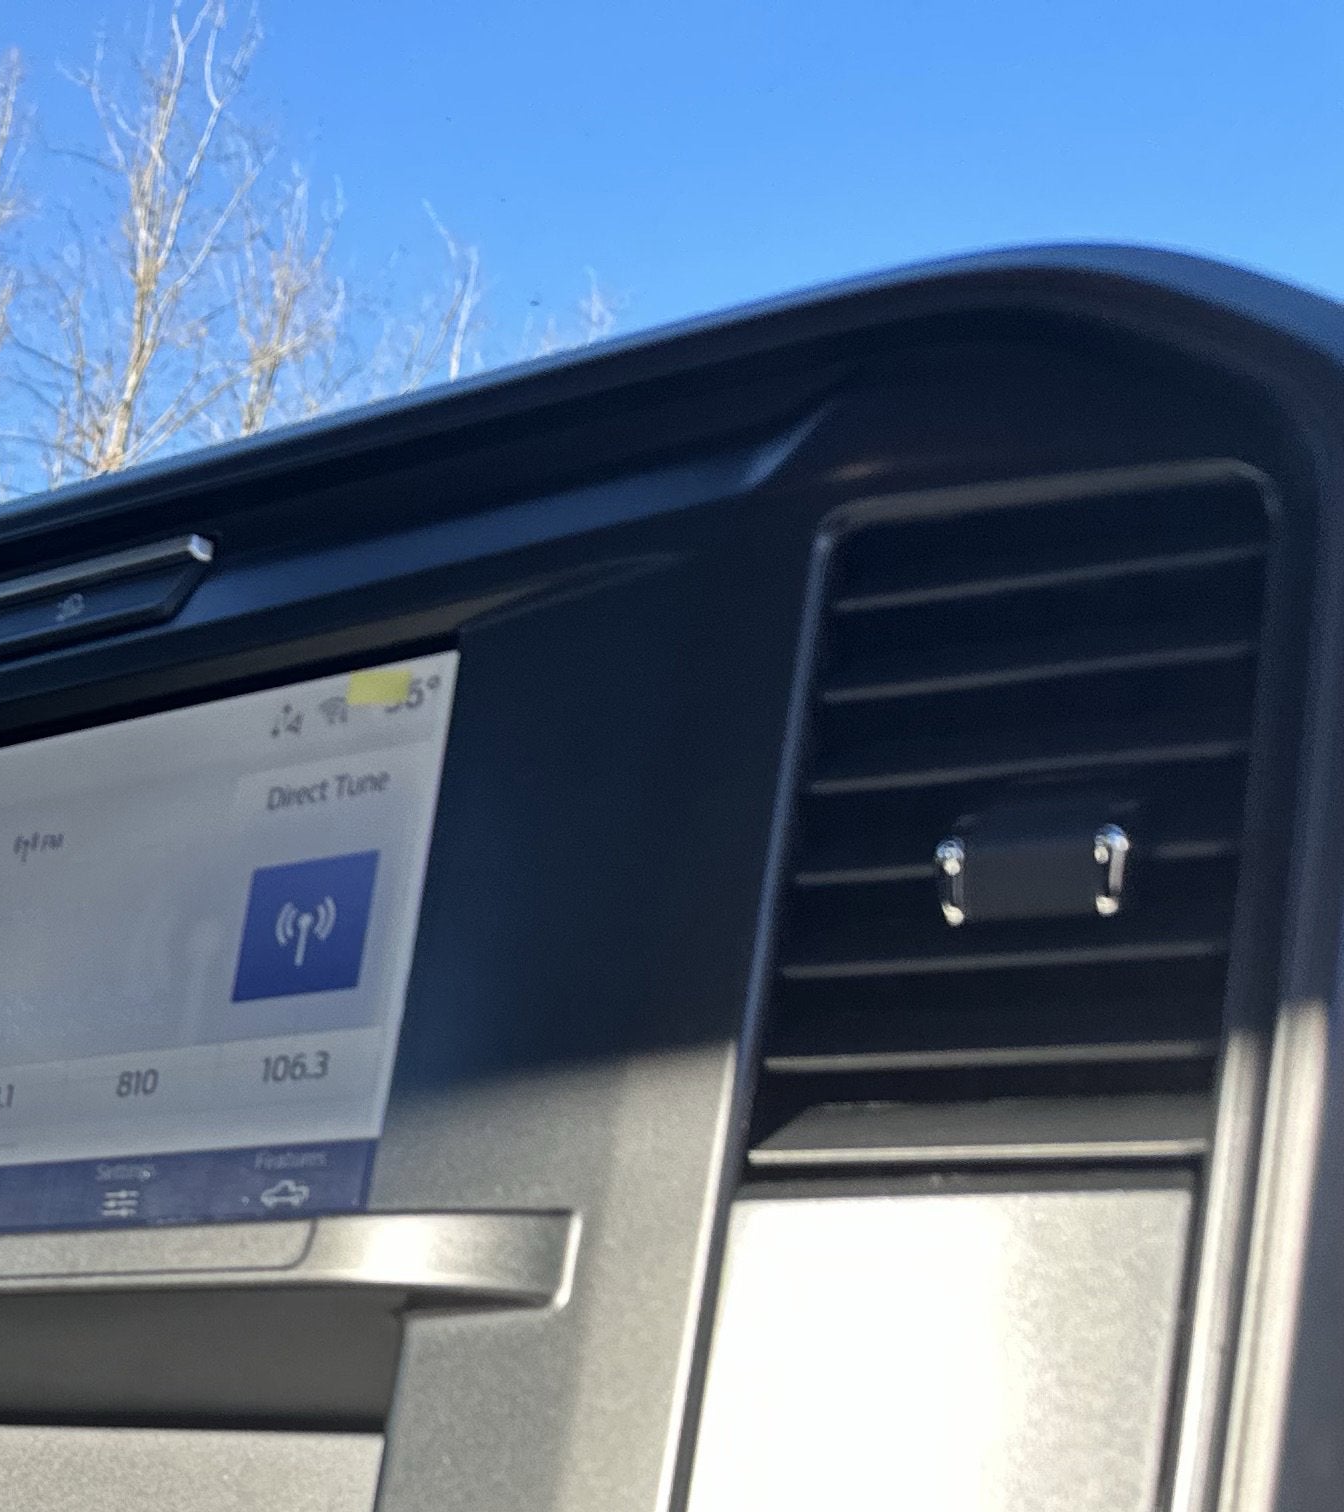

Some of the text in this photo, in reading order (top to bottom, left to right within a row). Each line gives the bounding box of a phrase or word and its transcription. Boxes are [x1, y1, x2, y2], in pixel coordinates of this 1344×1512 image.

[267, 771, 391, 811] Direct Tune
[261, 1050, 331, 1083] 106.3
[115, 1068, 160, 1099] 810
